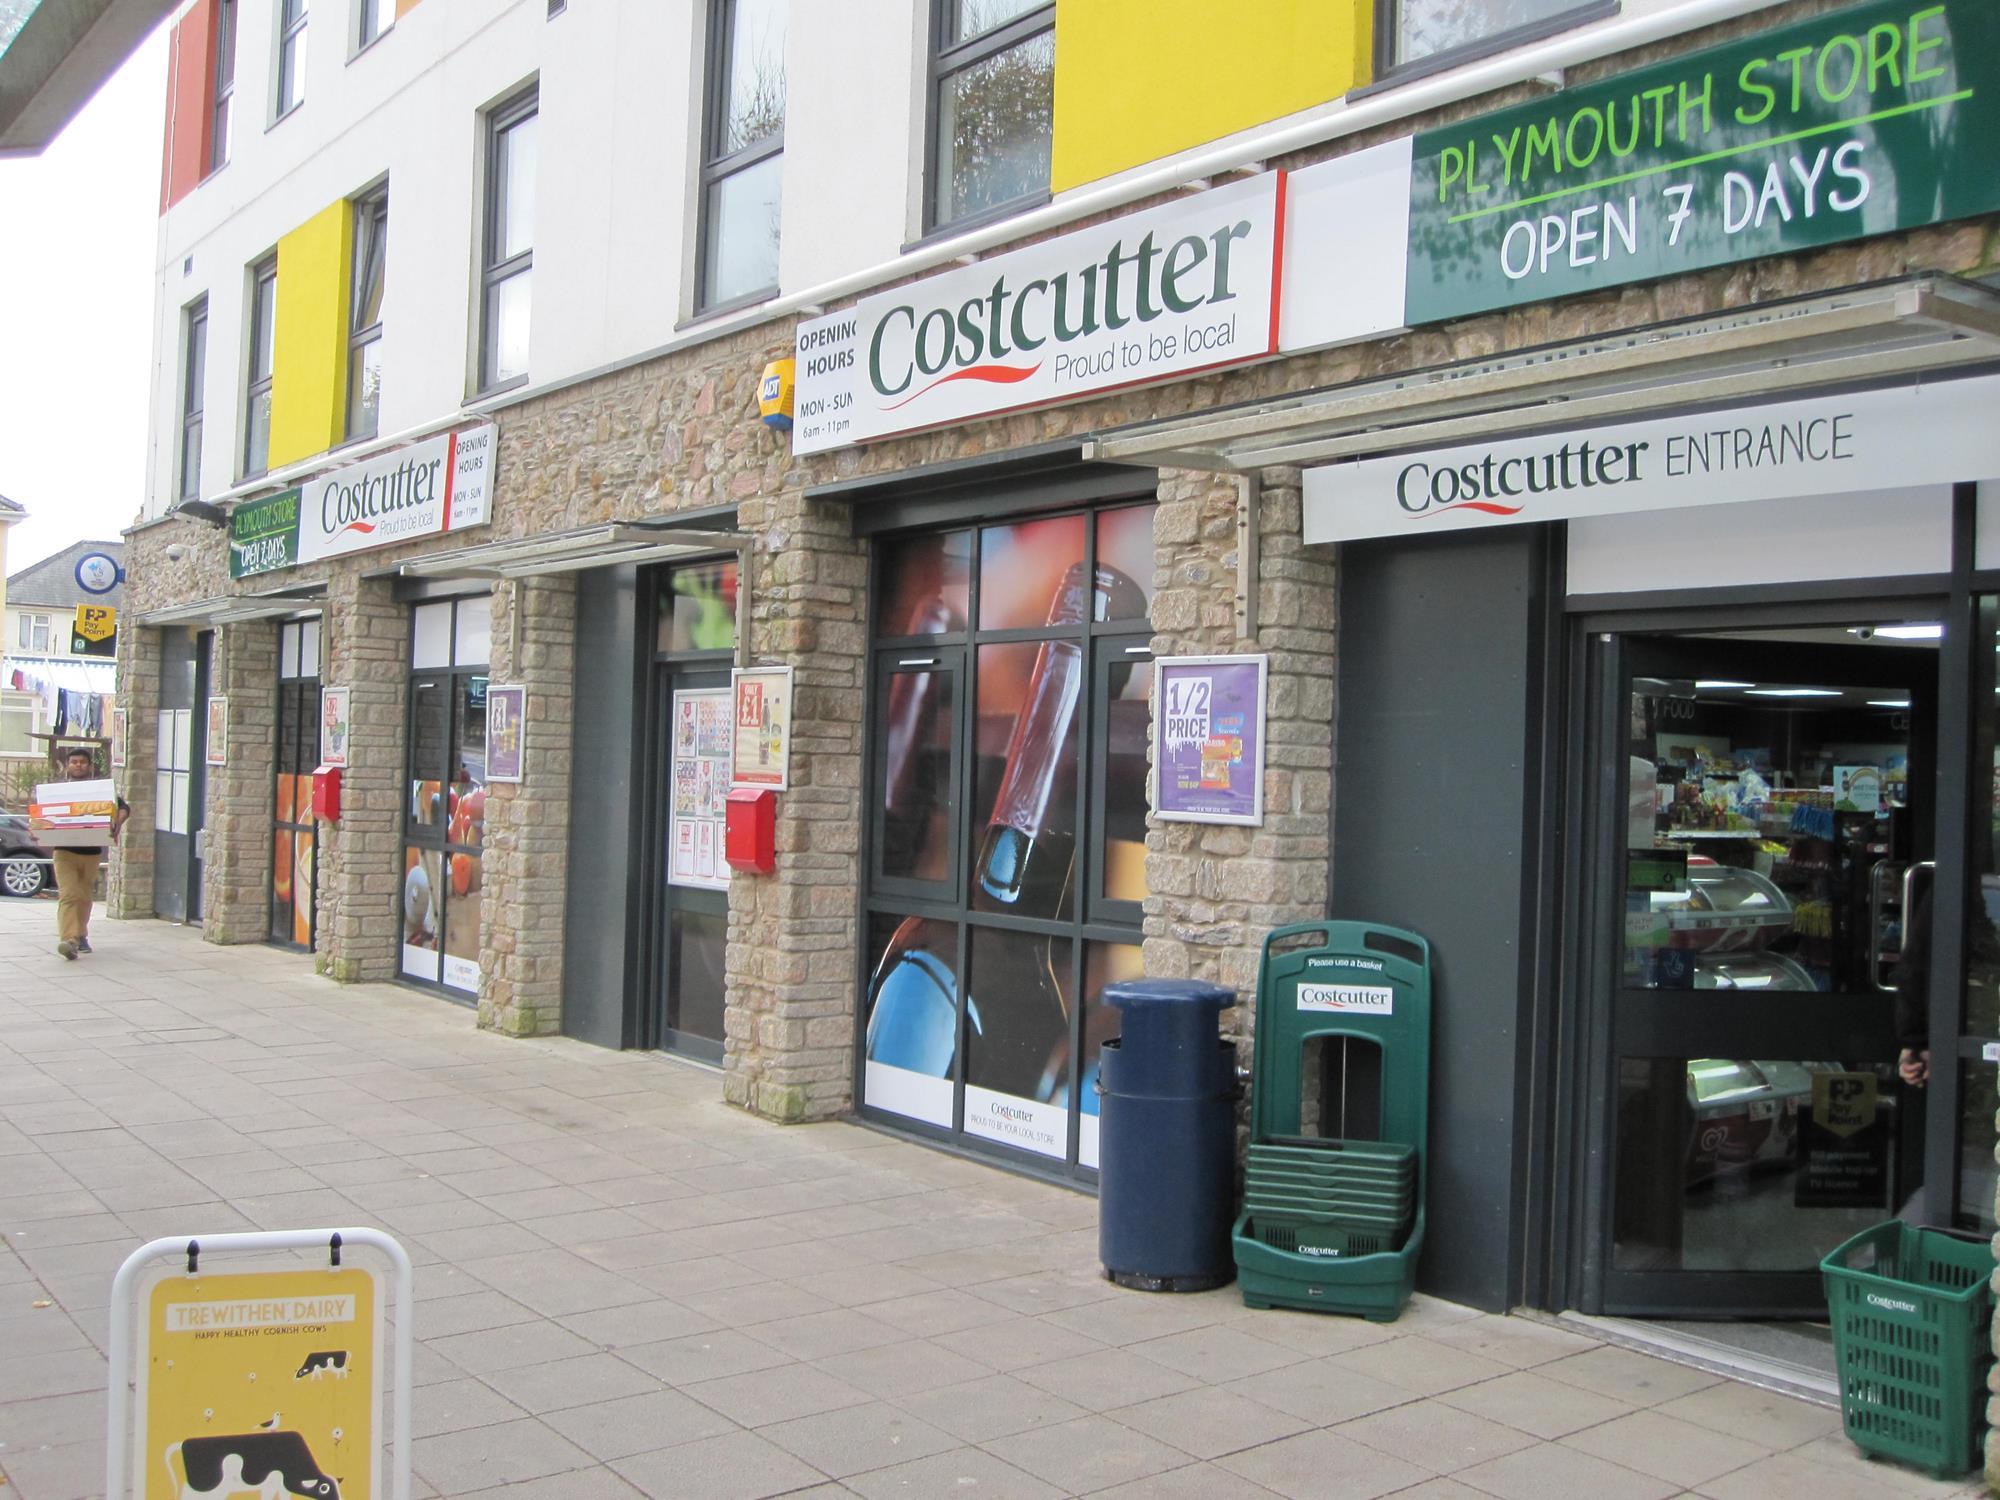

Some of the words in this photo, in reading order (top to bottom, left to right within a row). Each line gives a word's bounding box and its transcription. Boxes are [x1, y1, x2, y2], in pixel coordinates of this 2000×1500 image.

[1439, 73, 1712, 203] PLYMOUTH
[1735, 5, 1946, 125] STORE
[1501, 197, 1636, 280] OPEN
[1662, 184, 1694, 246] 7
[1723, 141, 1870, 234] DAYS
[868, 219, 1252, 396] Costcutter
[1054, 348, 1115, 383] Proud
[1121, 341, 1142, 368] to
[1148, 329, 1178, 361] be
[1184, 314, 1236, 357] local
[807, 348, 855, 378] HOURS
[801, 399, 825, 418] MON
[833, 392, 853, 410] SUN
[803, 425, 820, 439] 6am
[828, 419, 850, 434] 11pm
[456, 435, 488, 455] OPENING
[459, 456, 483, 474] HOURS
[1396, 437, 1649, 513] Costcutter
[1666, 414, 1854, 477] ENTRANCE
[322, 456, 440, 534] Costcutter
[470, 487, 482, 499] SUN
[235, 504, 271, 536] PLYMOUTH
[272, 496, 297, 525] STORE
[380, 519, 399, 536] Proud
[408, 513, 417, 530] be
[419, 507, 433, 527] local
[241, 541, 260, 567] OPEN
[268, 535, 286, 560] DAYS
[84, 627, 105, 635] Point
[85, 621, 99, 629] Pay
[1169, 681, 1210, 715] 1/2
[1663, 699, 1696, 720] FOOD
[742, 696, 759, 725] £1
[1168, 718, 1207, 738] PRICE
[1308, 959, 1333, 967] Please
[1357, 960, 1382, 971] basket
[1302, 987, 1388, 1005] Costcutter
[991, 1102, 1033, 1122] Costcutter
[1829, 1114, 1862, 1125] Point
[988, 1119, 995, 1129] TO
[1004, 1123, 1019, 1134] YOUR
[1020, 1127, 1035, 1140] LOCAL
[1037, 1132, 1055, 1145] STORE
[1299, 1245, 1339, 1256] Costcutter
[176, 1303, 285, 1326] TREWITHEN
[294, 1300, 347, 1320] DAIRY
[1867, 1293, 1917, 1313] Costcutter
[195, 1331, 220, 1339] HAPPY
[224, 1329, 260, 1338] HEALTHY
[264, 1327, 299, 1336] CORNISH
[303, 1325, 327, 1333] COWS
